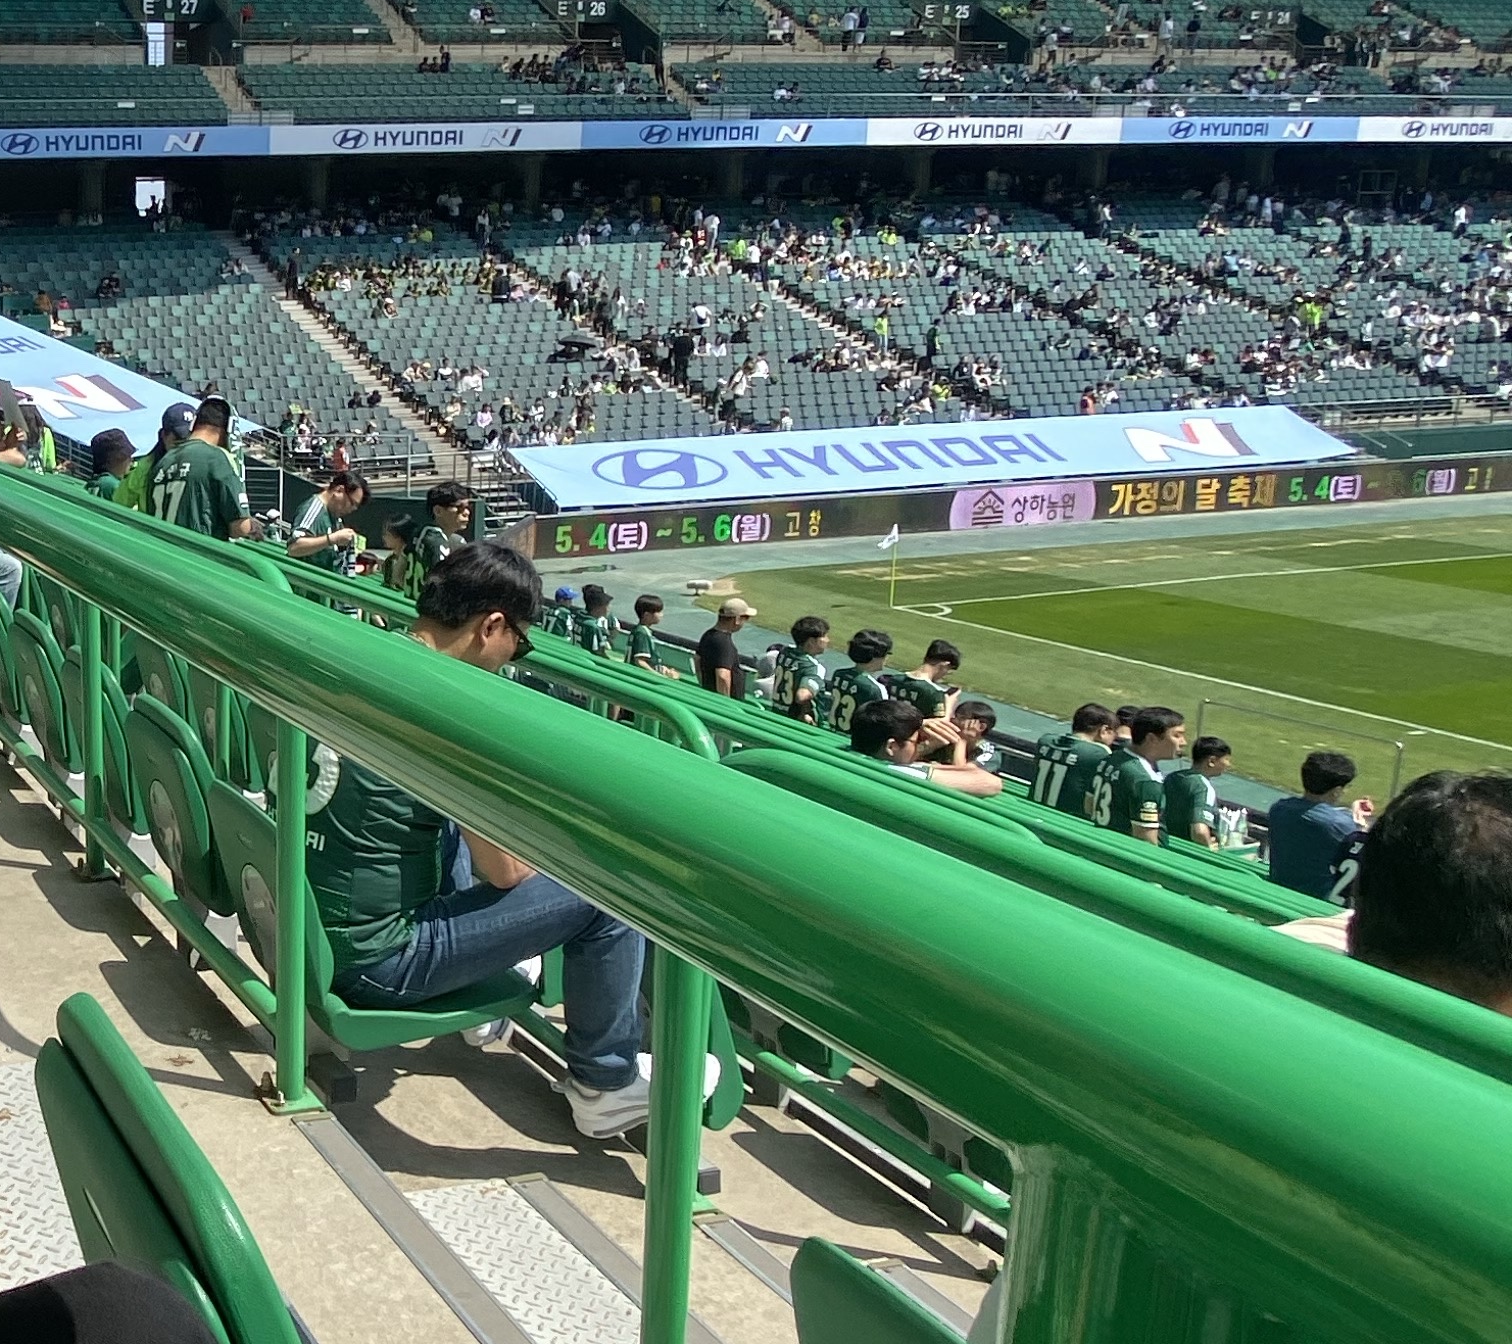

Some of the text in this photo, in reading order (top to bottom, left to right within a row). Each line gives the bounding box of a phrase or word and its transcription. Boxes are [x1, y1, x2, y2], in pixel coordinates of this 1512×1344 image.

[557, 0, 607, 17] E 26
[925, 5, 971, 20] E 25
[373, 129, 464, 148] HYUNDAI
[677, 125, 760, 143] HYUNDAI
[947, 123, 1024, 141] HYUNDAI
[1199, 122, 1269, 138] HYUNDAI
[1429, 122, 1494, 137] HYUNDAI
[44, 133, 143, 153] HYUNDAI
[735, 432, 1068, 480] HYUNDAI
[152, 480, 187, 524] 17
[1108, 480, 1185, 518] 가정의
[1195, 477, 1220, 510] 달
[1227, 473, 1277, 509] 축제
[1010, 493, 1076, 525] 상하농원
[1034, 758, 1068, 808] 11
